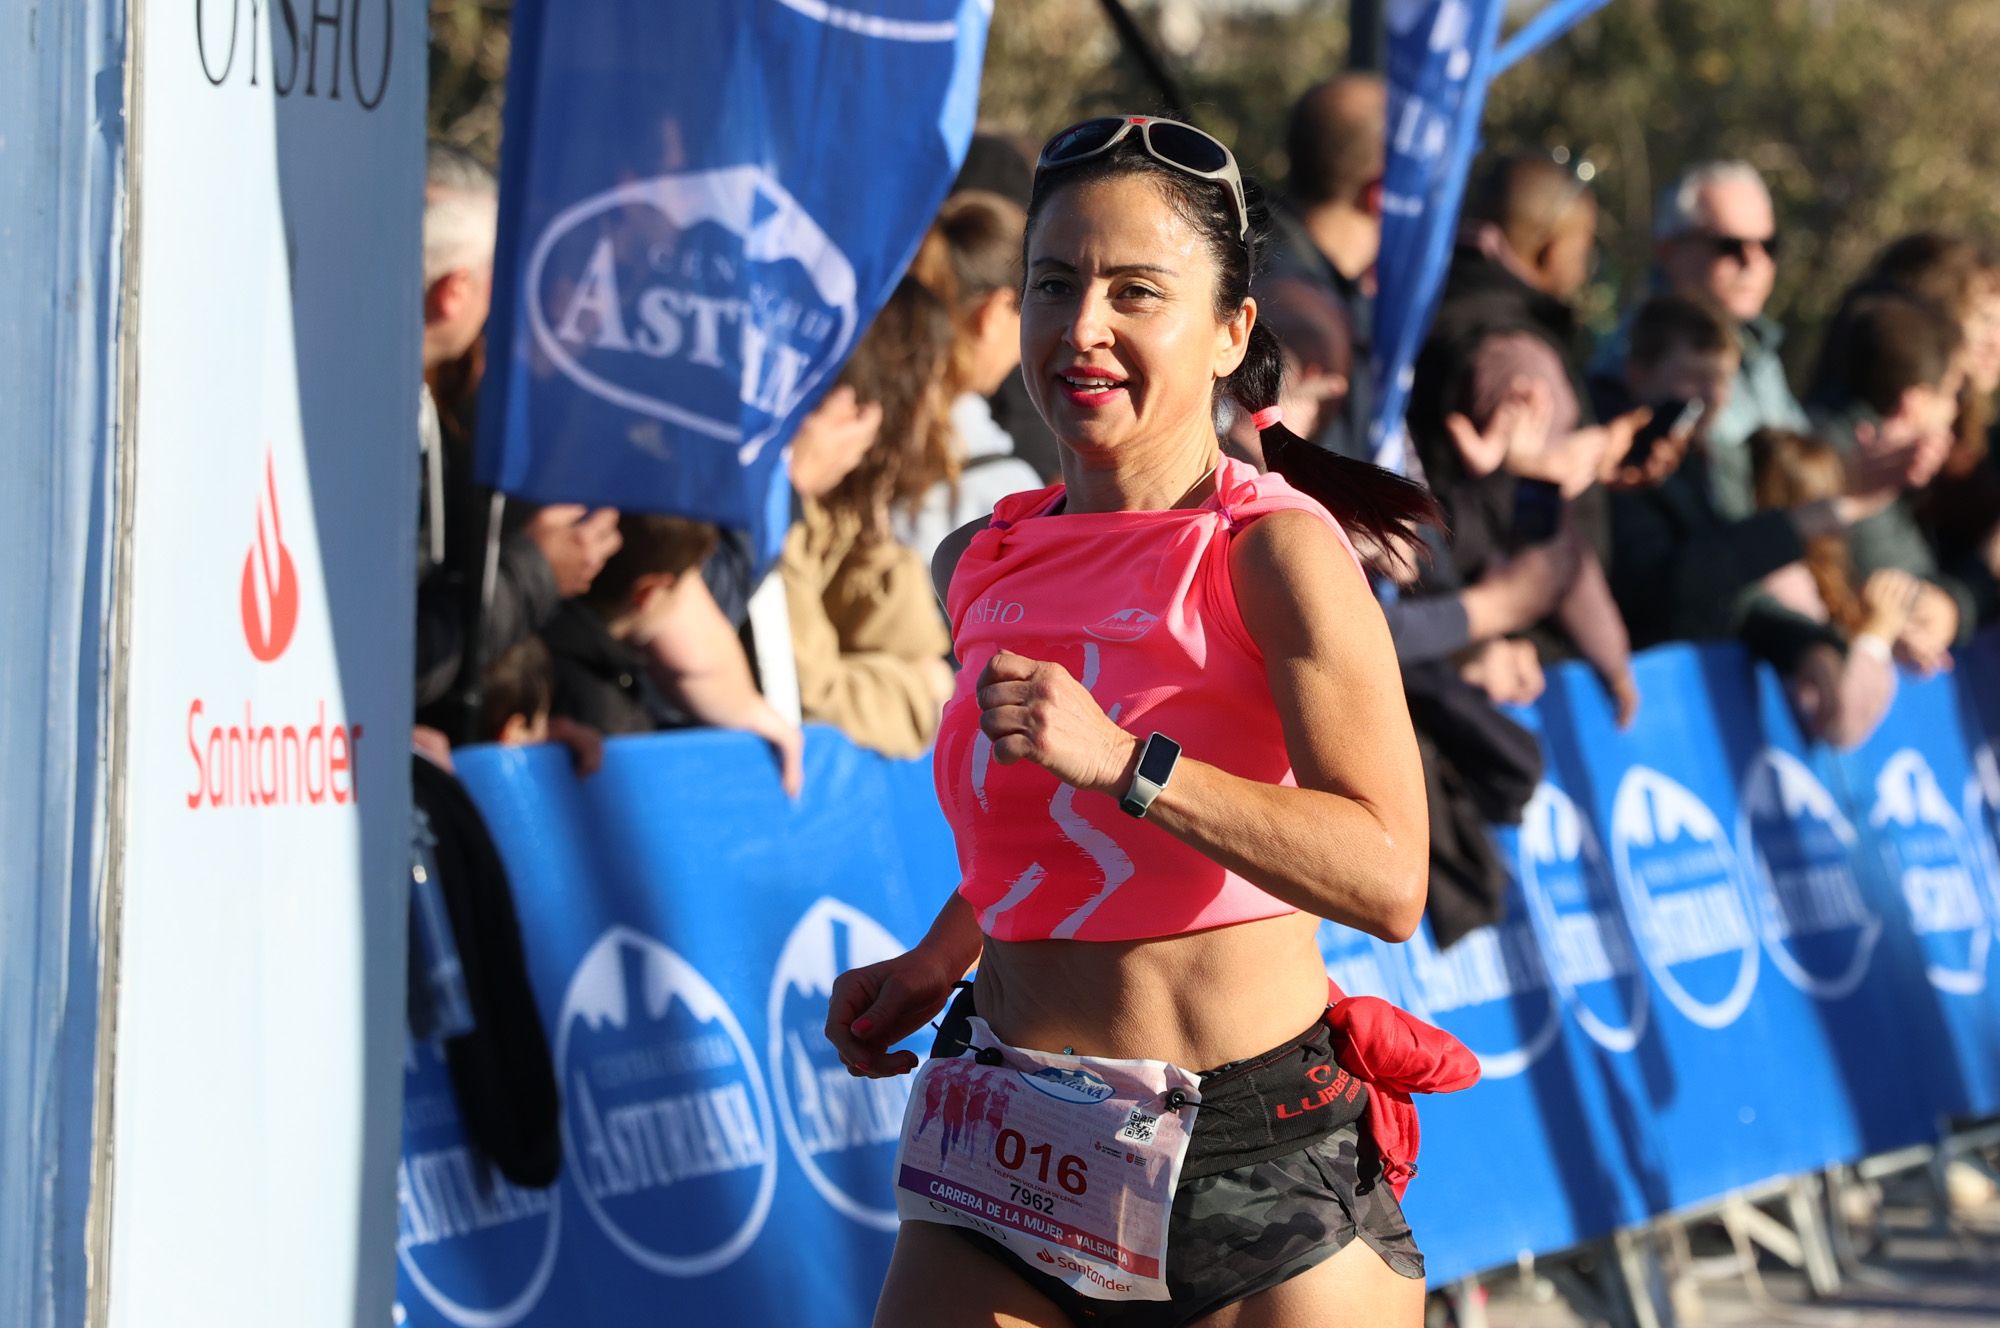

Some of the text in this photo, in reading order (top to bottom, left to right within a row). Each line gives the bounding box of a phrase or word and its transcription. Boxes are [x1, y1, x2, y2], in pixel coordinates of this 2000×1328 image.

[188, 697, 364, 811] Santander
[1276, 1067, 1350, 1119] LURBE
[994, 1128, 1088, 1196] 016
[929, 1181, 1129, 1266] CARRERA DE LA MUJER VALENCIA
[1010, 1183, 1054, 1216] 7962
[1057, 1256, 1133, 1292] Santander
